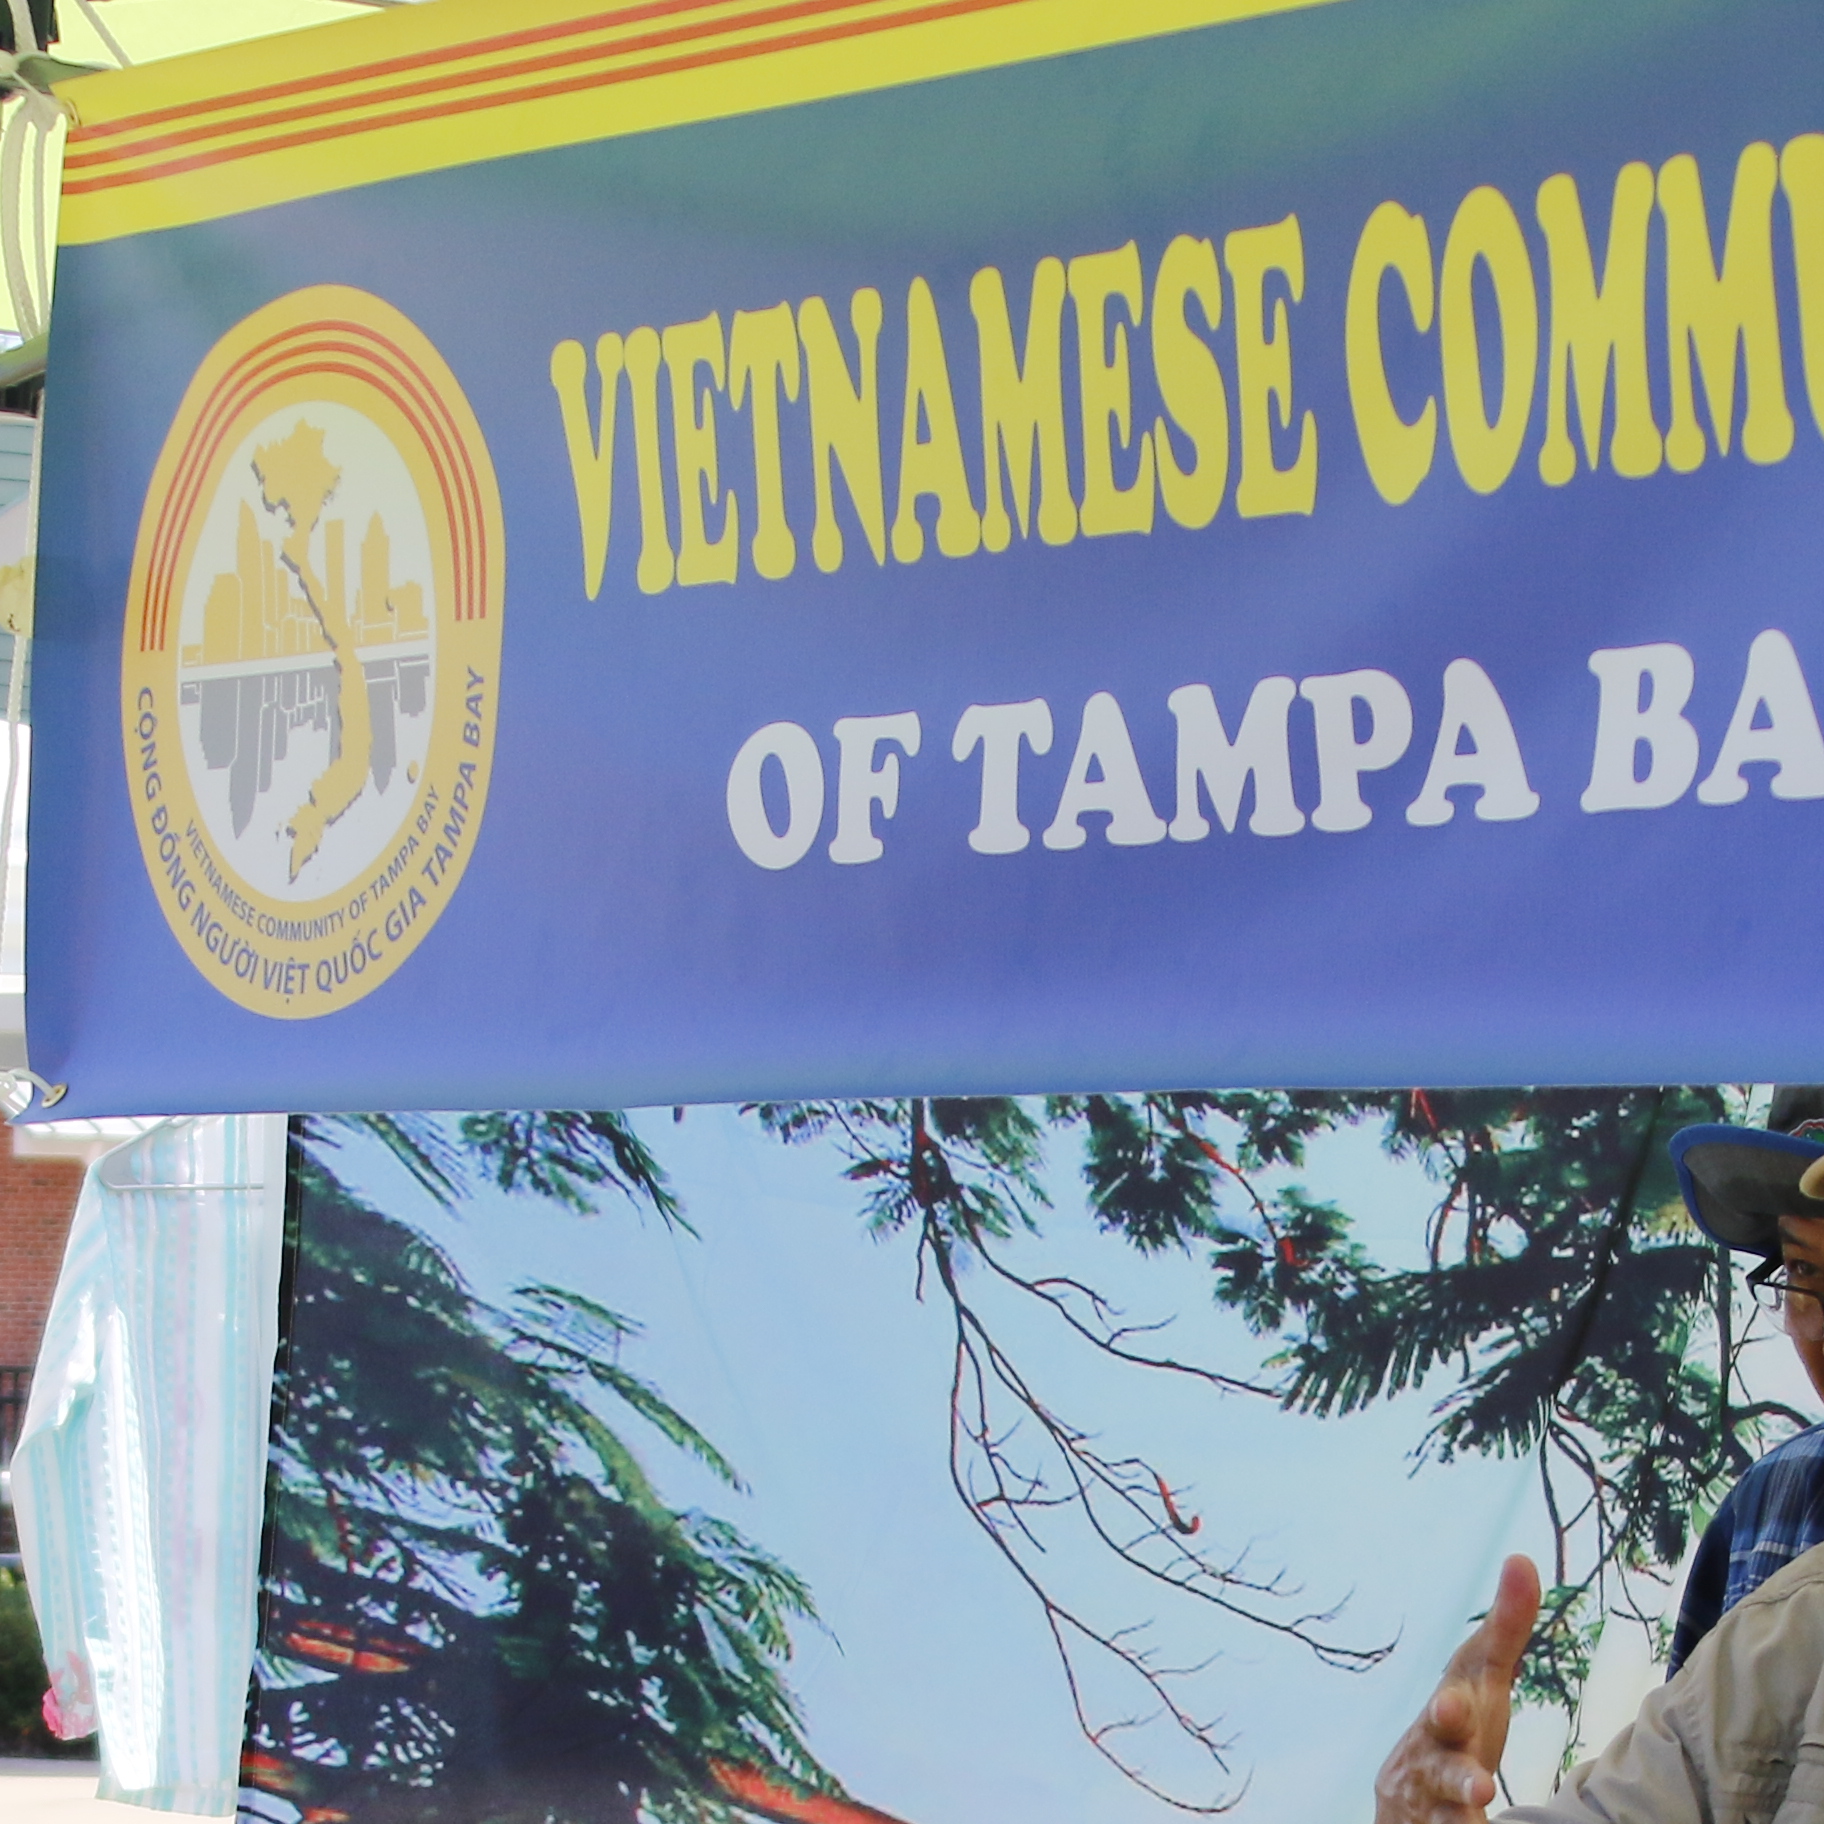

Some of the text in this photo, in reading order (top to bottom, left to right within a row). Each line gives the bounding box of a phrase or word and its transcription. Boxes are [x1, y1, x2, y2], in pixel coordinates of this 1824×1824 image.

[550, 212, 1317, 601] VIETNAMESE
[134, 667, 486, 1005] CỘNG ĐỒNG NGƯỜI VIỆT QUỐC GIA TAMPA BAY
[185, 785, 441, 943] VIETNAMESE COMMUNITY OF TAMPA BAY
[724, 709, 923, 872] OF
[949, 655, 1542, 856] TAMPA
